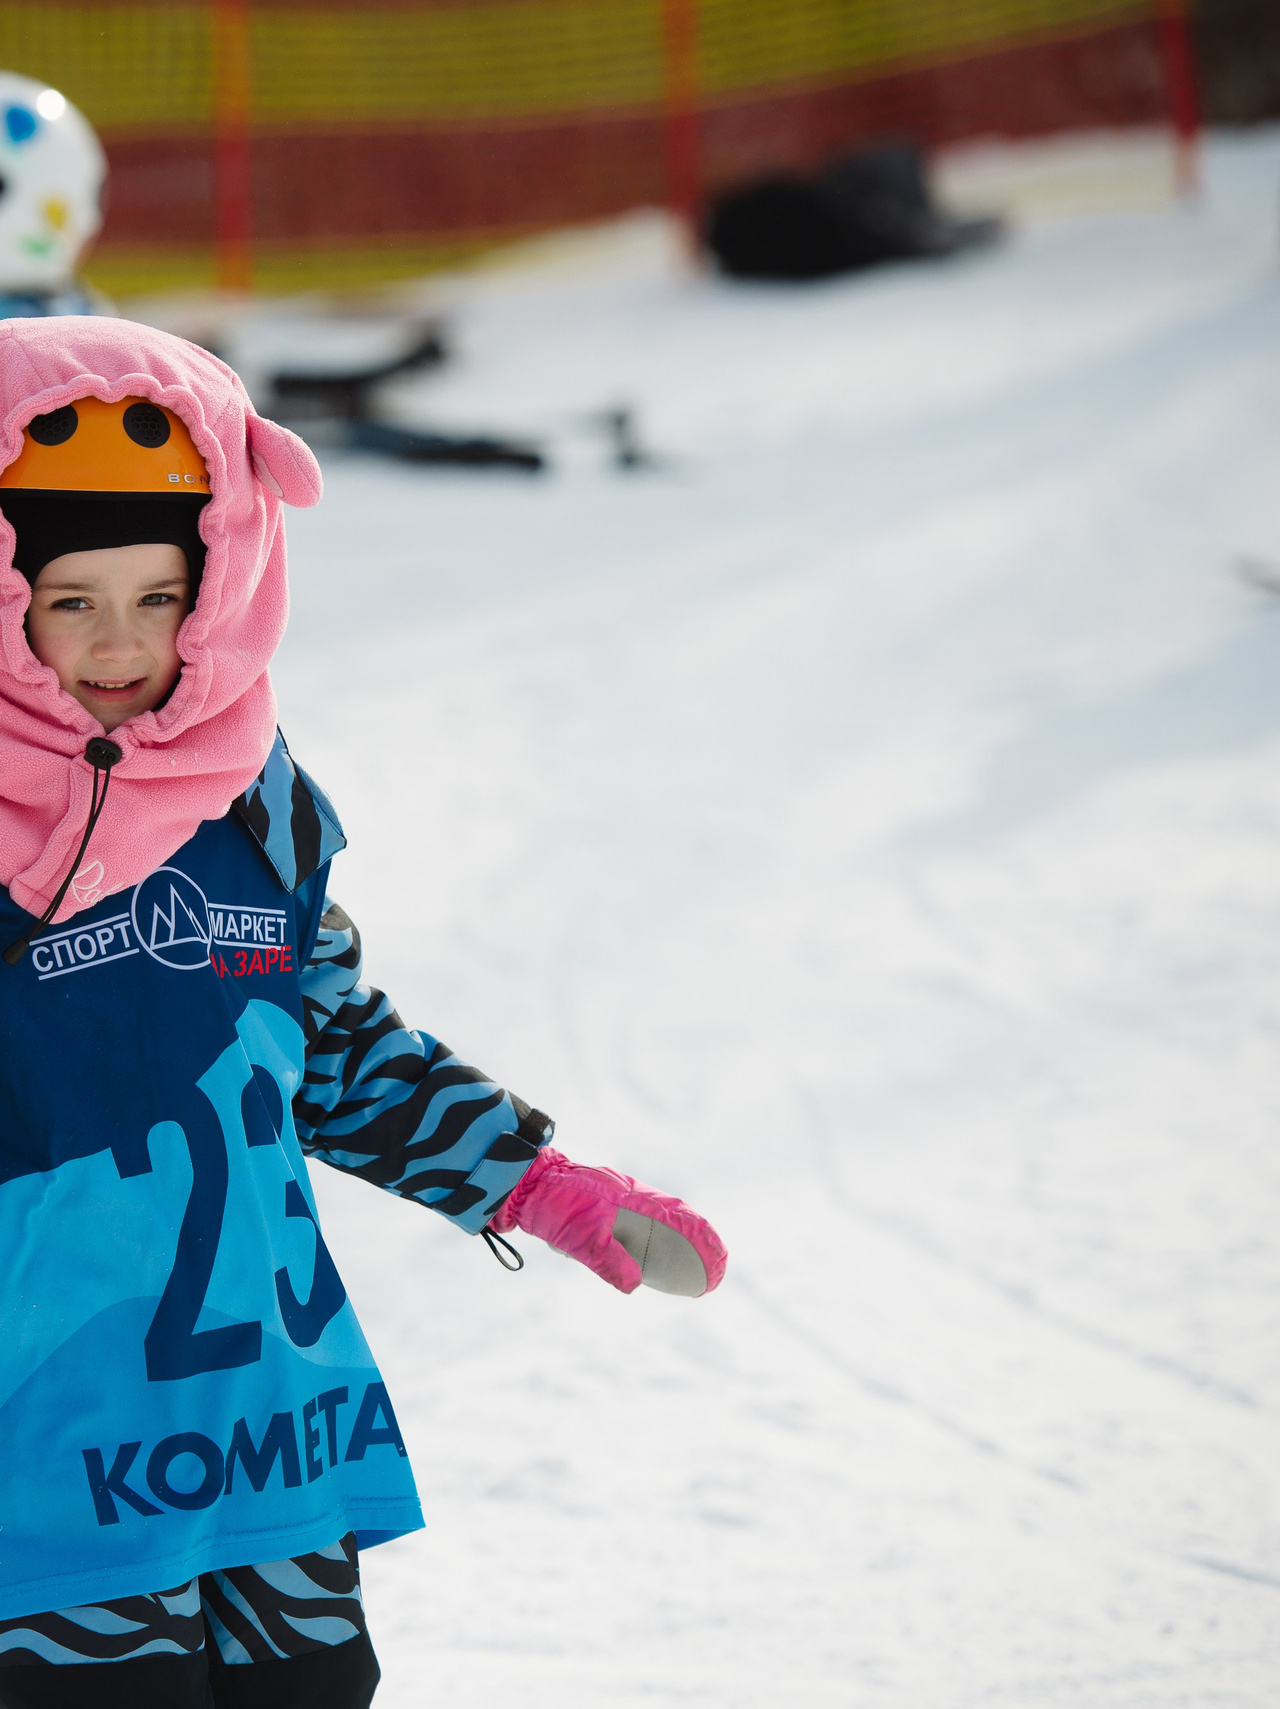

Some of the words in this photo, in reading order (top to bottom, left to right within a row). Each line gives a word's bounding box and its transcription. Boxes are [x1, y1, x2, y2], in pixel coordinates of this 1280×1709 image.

[32, 919, 132, 973] СПОРТ
[209, 910, 288, 944] МАРКЕТ
[233, 945, 293, 978] ЗАРЕ
[110, 1062, 348, 1383] 23
[81, 1381, 409, 1527] КОМЕТА
